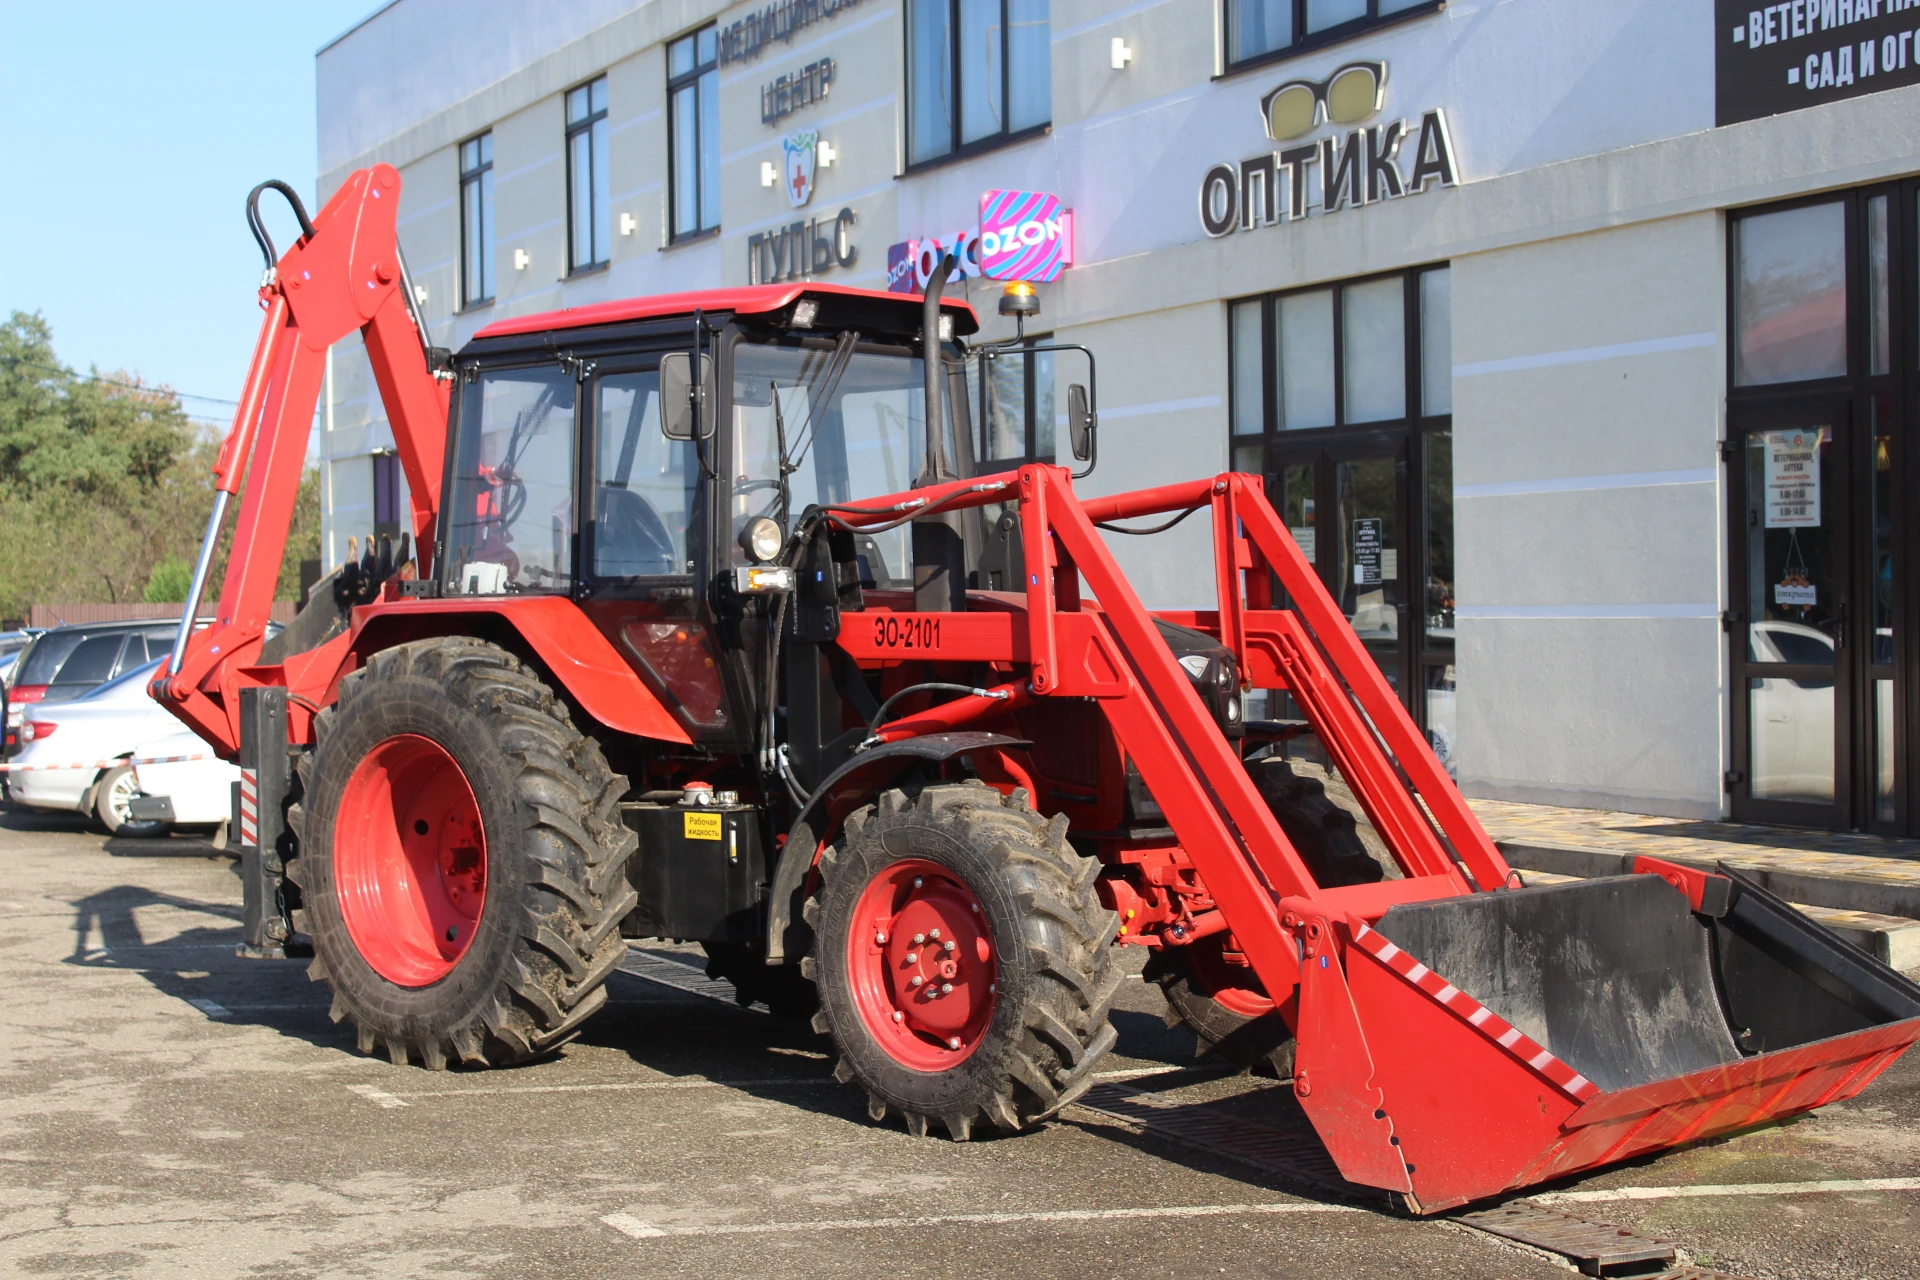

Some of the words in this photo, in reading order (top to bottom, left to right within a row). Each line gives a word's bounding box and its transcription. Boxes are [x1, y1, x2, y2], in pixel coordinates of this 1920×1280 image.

[716, 0, 860, 67] МЕДИЦИНС
[1749, 0, 1920, 49] ВЕТЕРИНАР
[1805, 45, 1854, 90] САД
[1859, 39, 1875, 78] И
[761, 57, 835, 127] ЦЕНТР
[1199, 107, 1460, 238] ОПТИКА
[748, 207, 857, 286] ПУЛЬС
[983, 216, 1063, 256] OZON
[1776, 591, 1815, 600] открыто
[874, 616, 940, 649] ЭО-2101
[687, 828, 720, 837] жидкость
[689, 816, 717, 826] Рабочая
